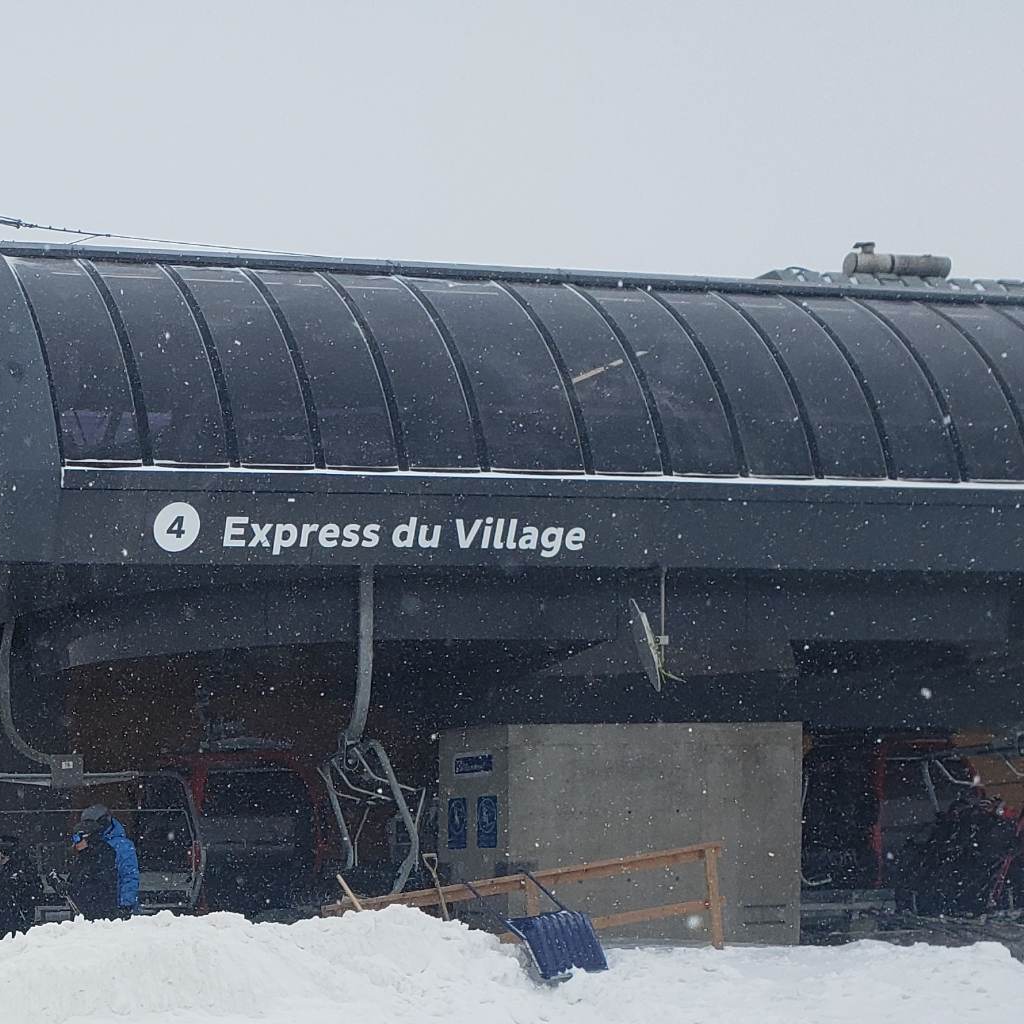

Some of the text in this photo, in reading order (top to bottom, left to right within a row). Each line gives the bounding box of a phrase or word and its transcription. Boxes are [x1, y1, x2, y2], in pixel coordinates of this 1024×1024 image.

[166, 516, 586, 558] 4 Express du Village
